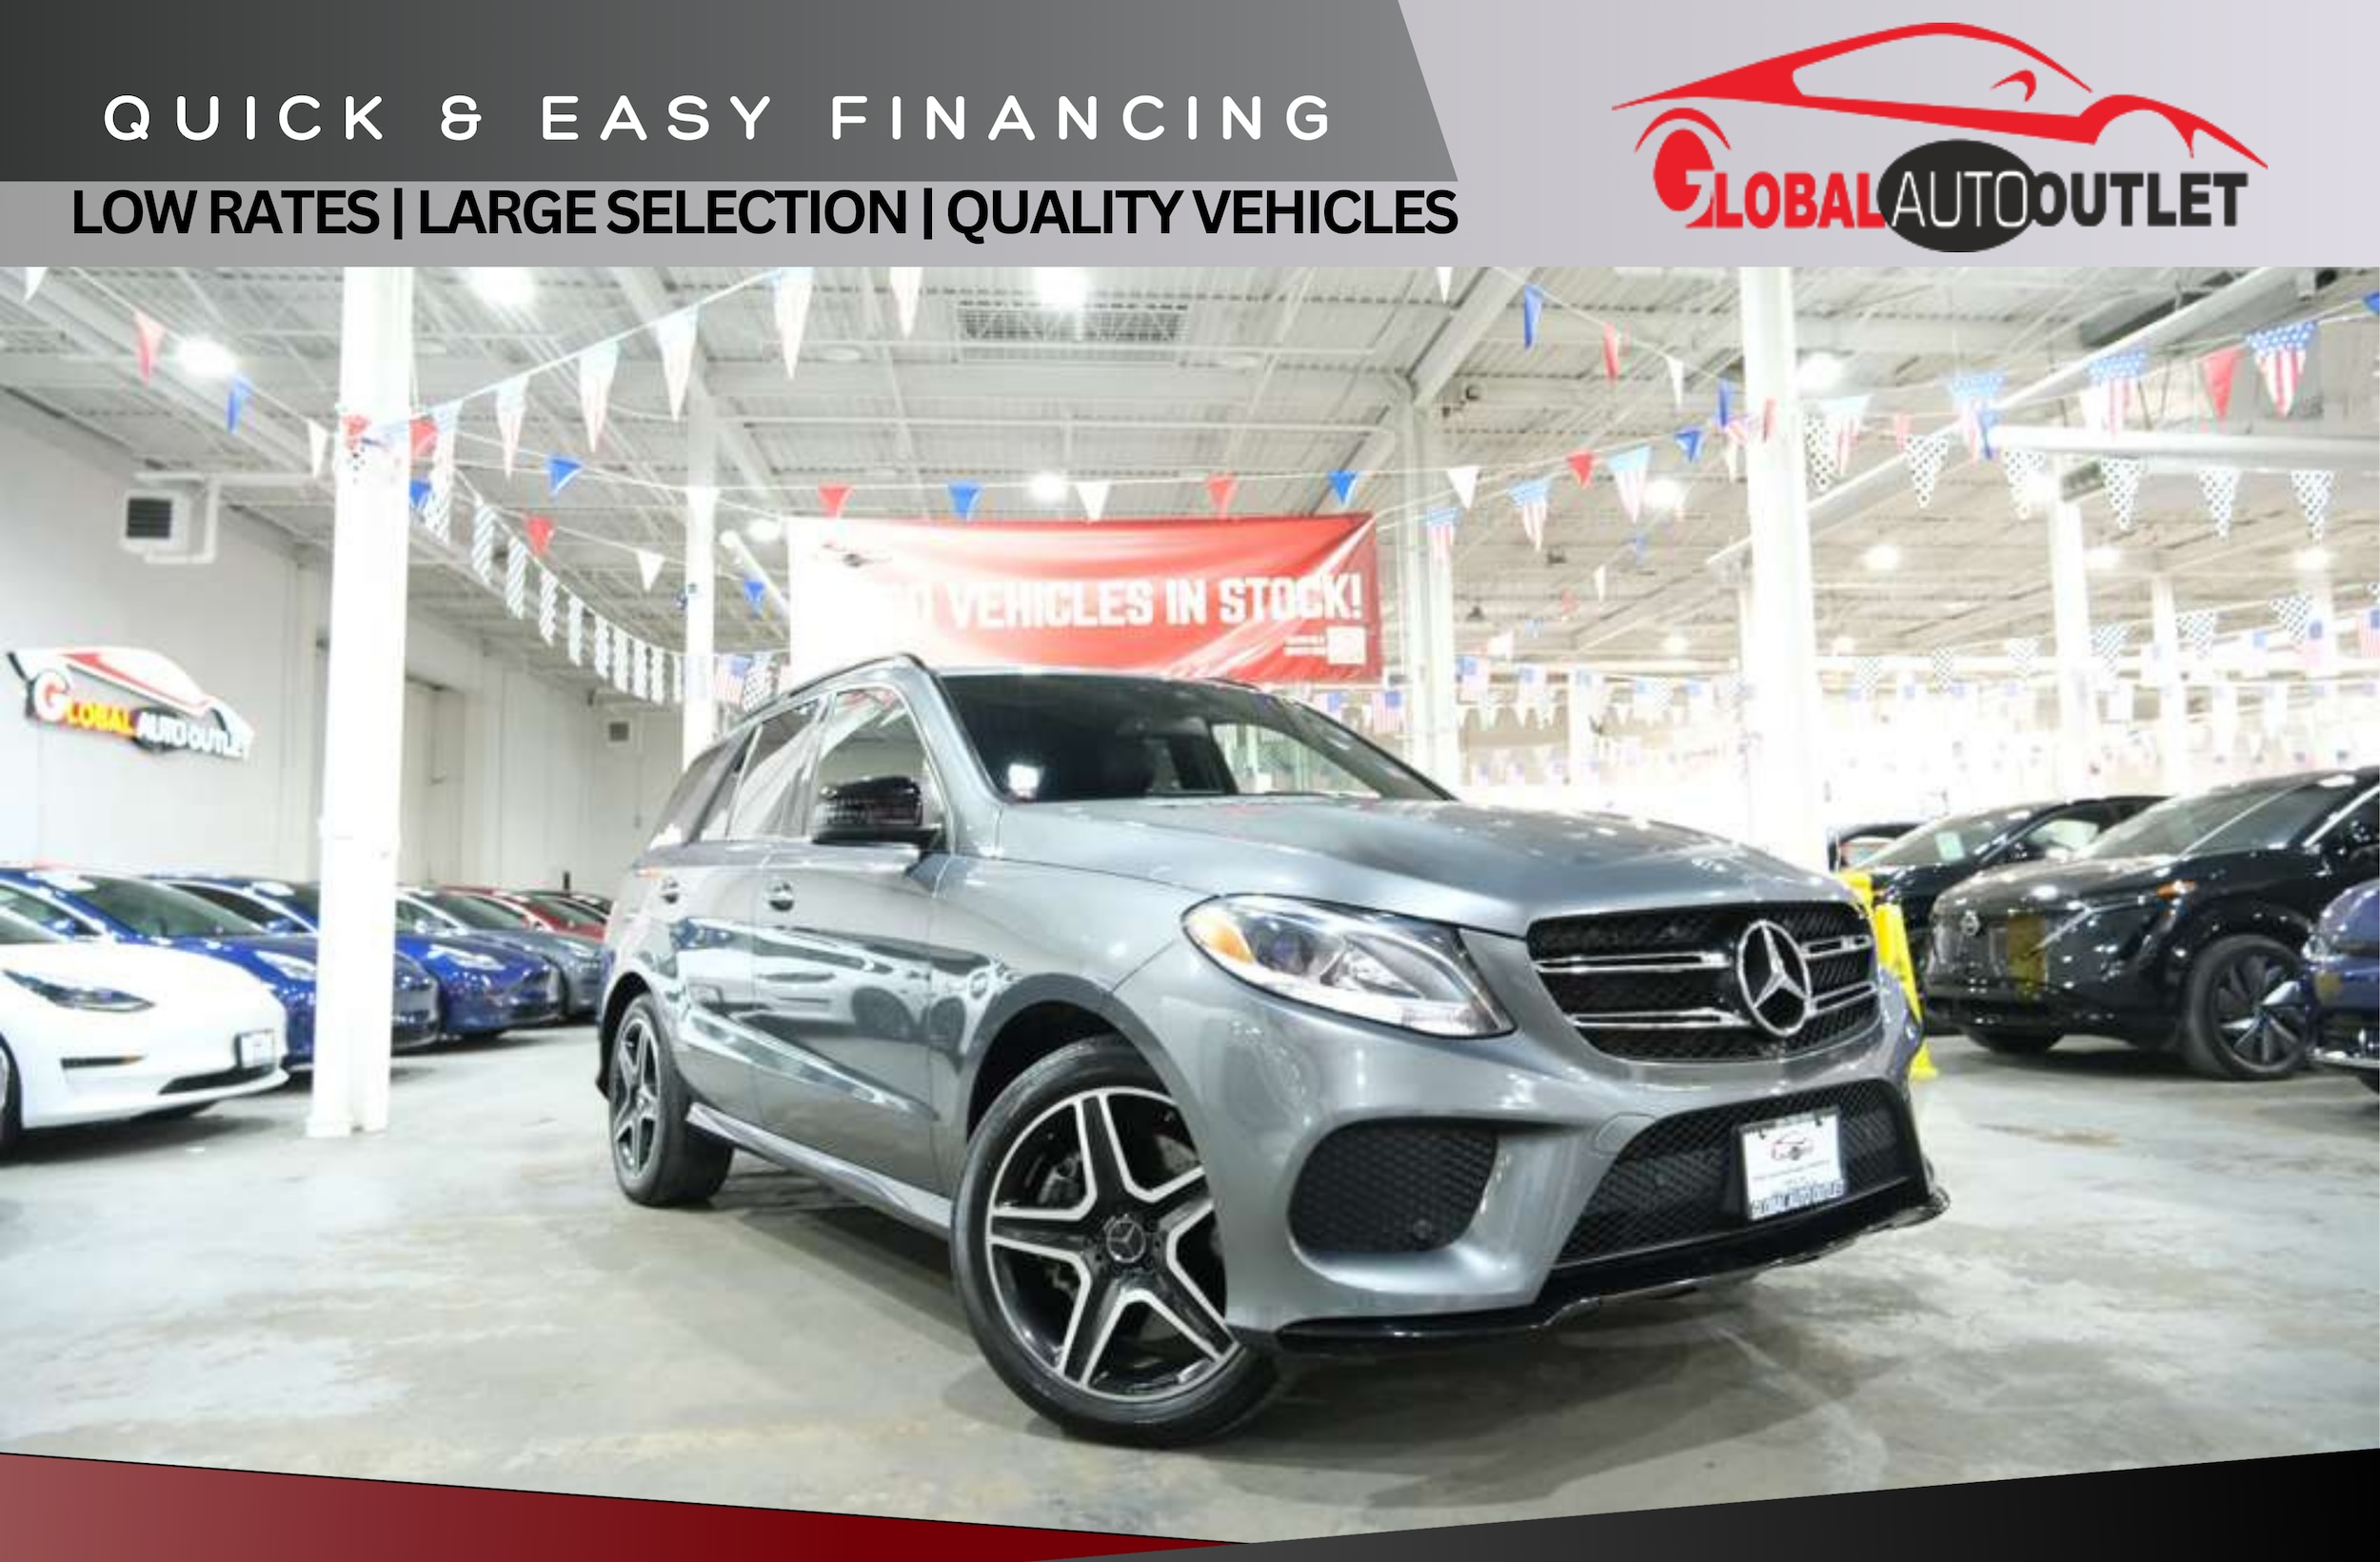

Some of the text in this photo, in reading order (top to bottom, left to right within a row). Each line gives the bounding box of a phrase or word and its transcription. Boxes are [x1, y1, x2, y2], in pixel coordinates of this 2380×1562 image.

[946, 578, 1155, 629] VEHICLES
[1165, 578, 1207, 625] IN
[1218, 573, 1363, 624] STOCK!
[33, 670, 135, 737] GLOBAL
[137, 712, 188, 745] AUTO
